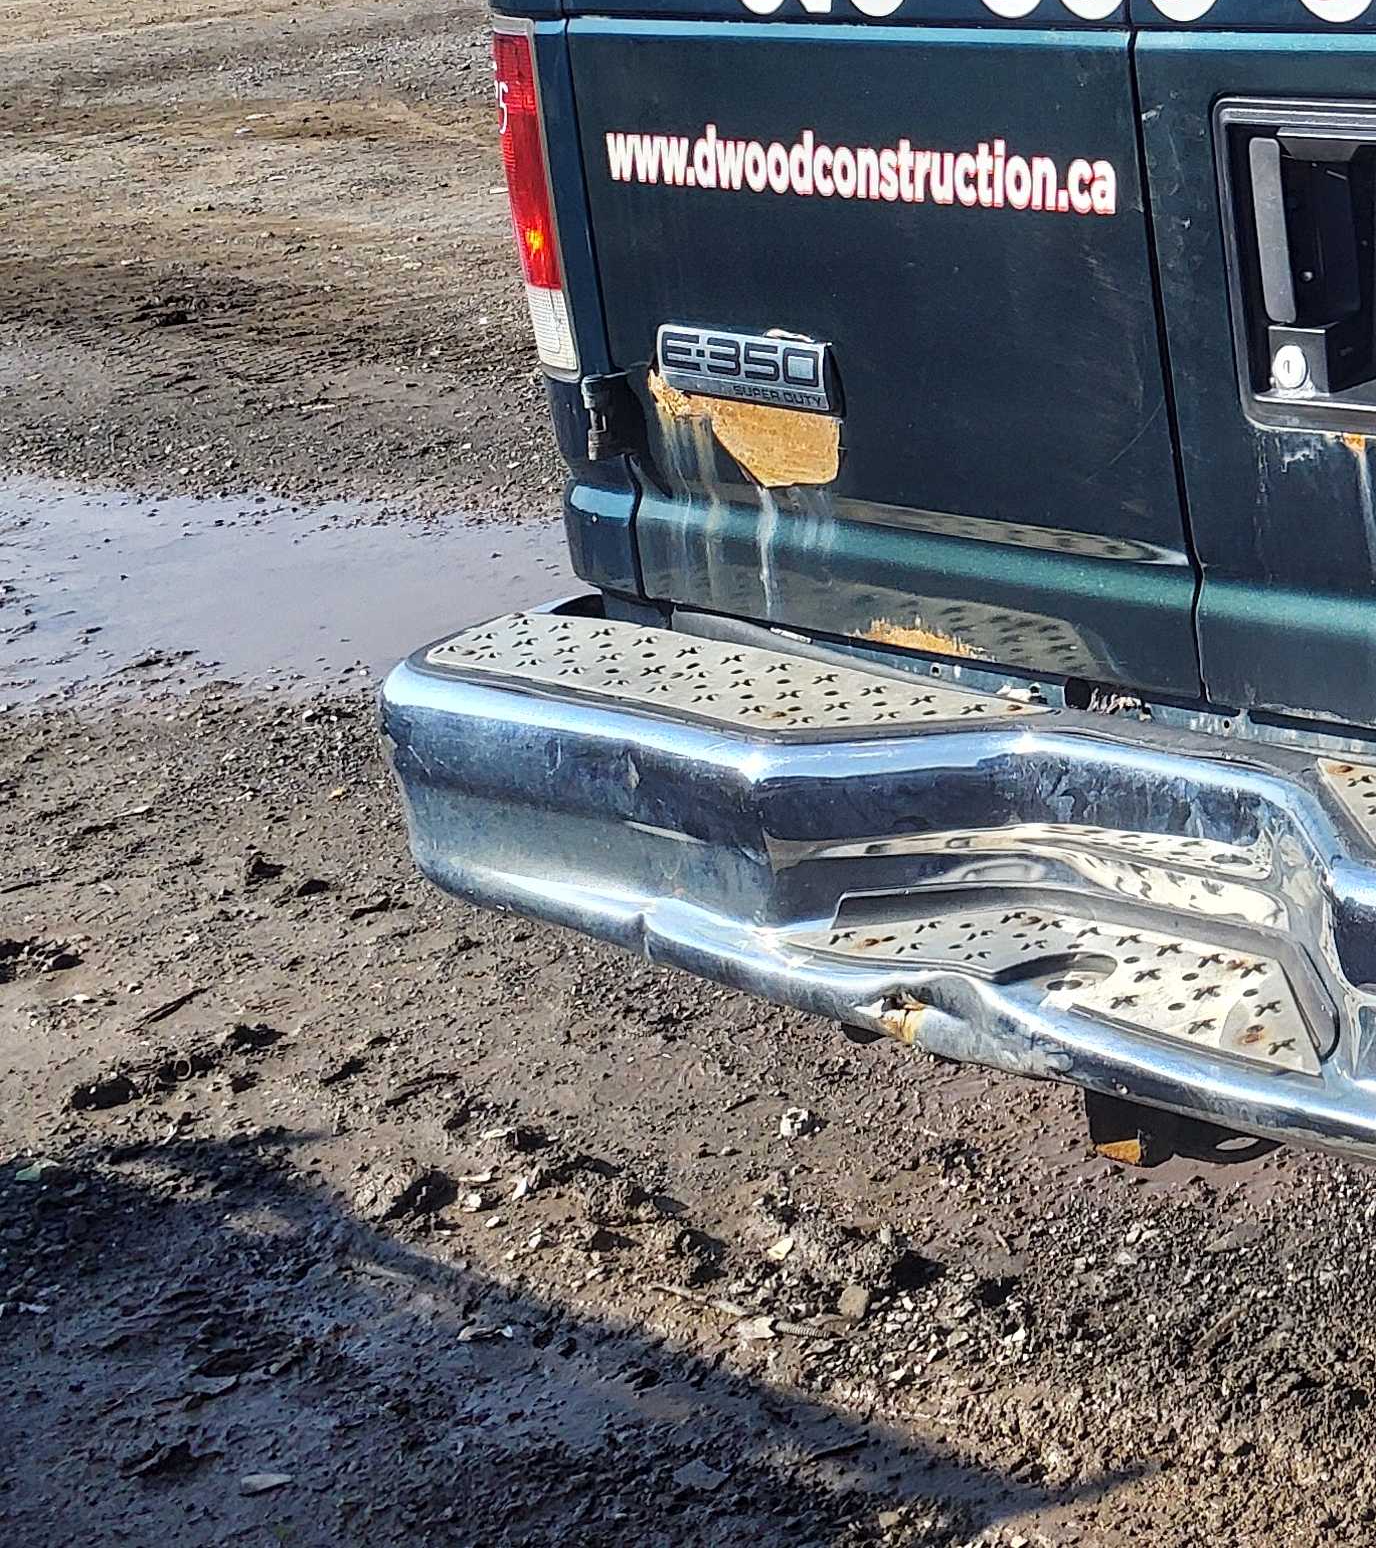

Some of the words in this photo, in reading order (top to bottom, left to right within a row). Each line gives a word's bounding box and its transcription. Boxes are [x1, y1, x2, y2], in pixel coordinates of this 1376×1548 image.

[605, 123, 1117, 216] www.dwoodconstruction.ca
[733, 384, 780, 401] SUPER
[784, 391, 822, 408] DUTY
